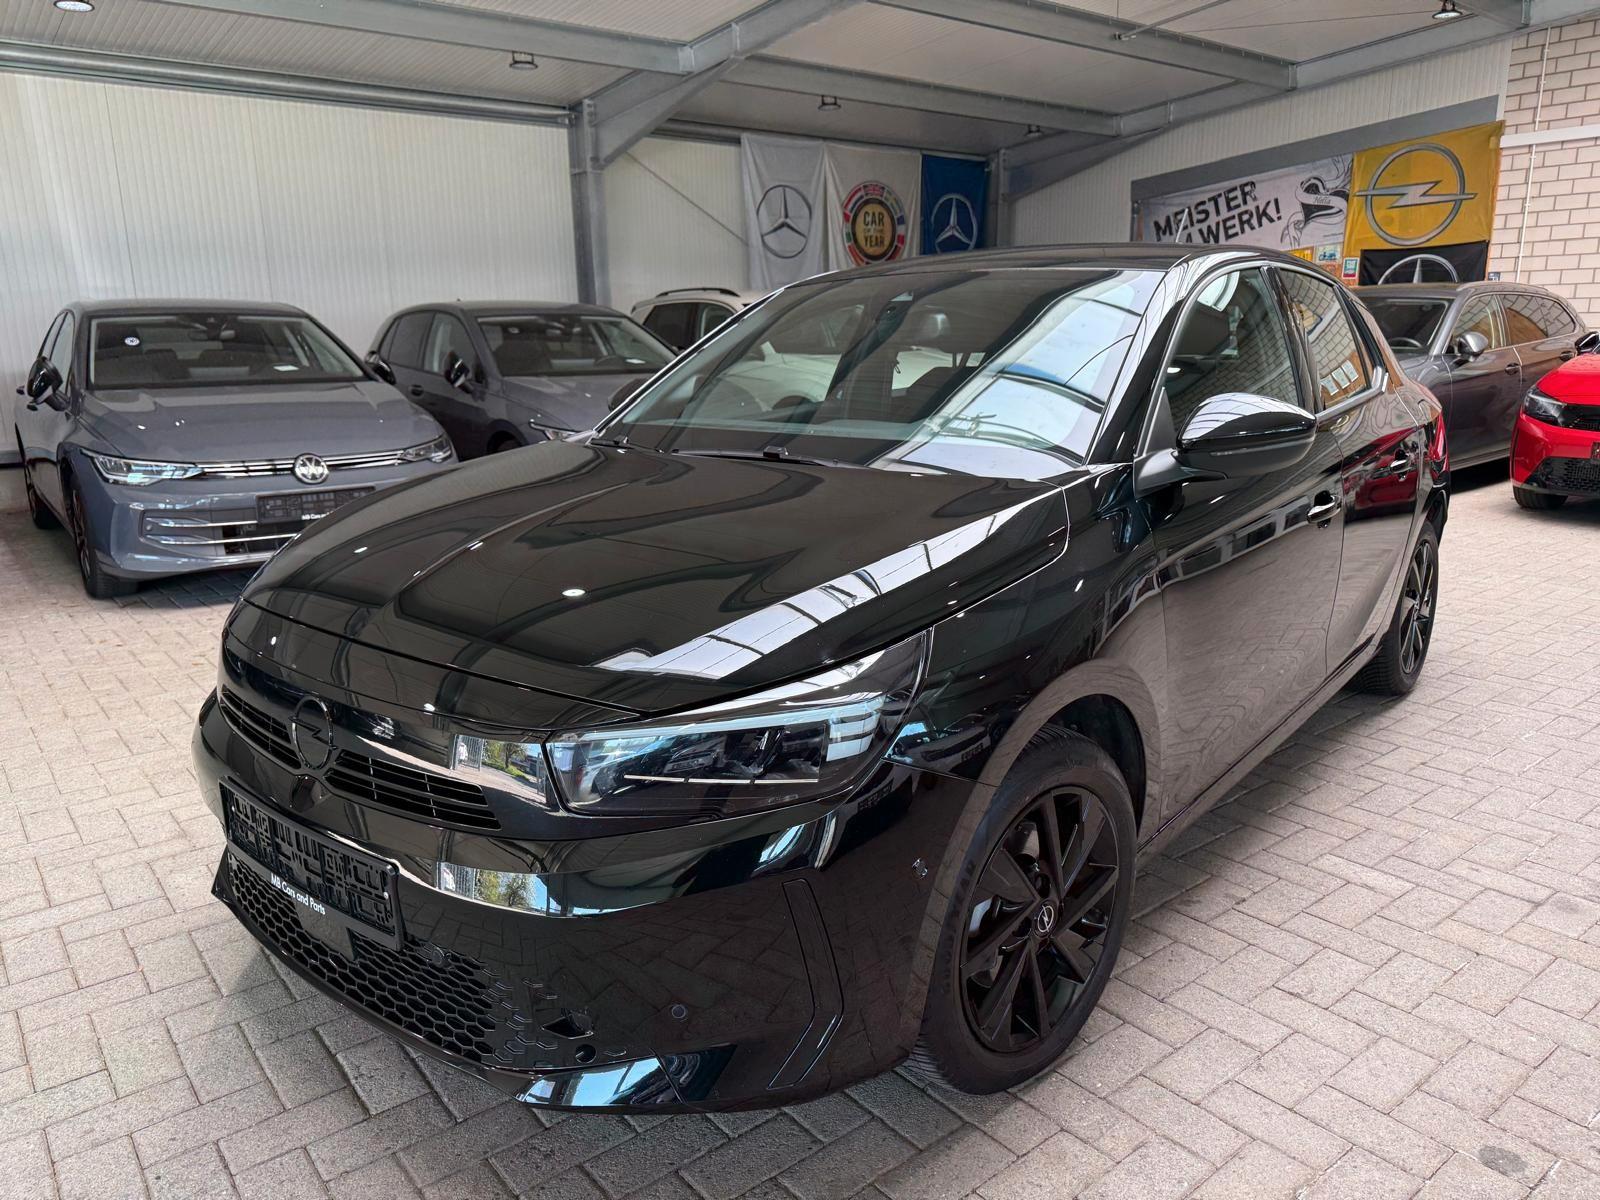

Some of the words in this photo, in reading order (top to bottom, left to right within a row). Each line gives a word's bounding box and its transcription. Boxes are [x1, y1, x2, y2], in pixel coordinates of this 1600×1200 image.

[864, 211, 885, 226] CAR
[1153, 181, 1257, 242] MEISTER
[1198, 198, 1282, 243] WERK!
[864, 235, 885, 248] YEAR
[271, 872, 281, 888] MB
[281, 881, 295, 898] Cars
[296, 893, 309, 906] and
[309, 897, 326, 915] Parts
